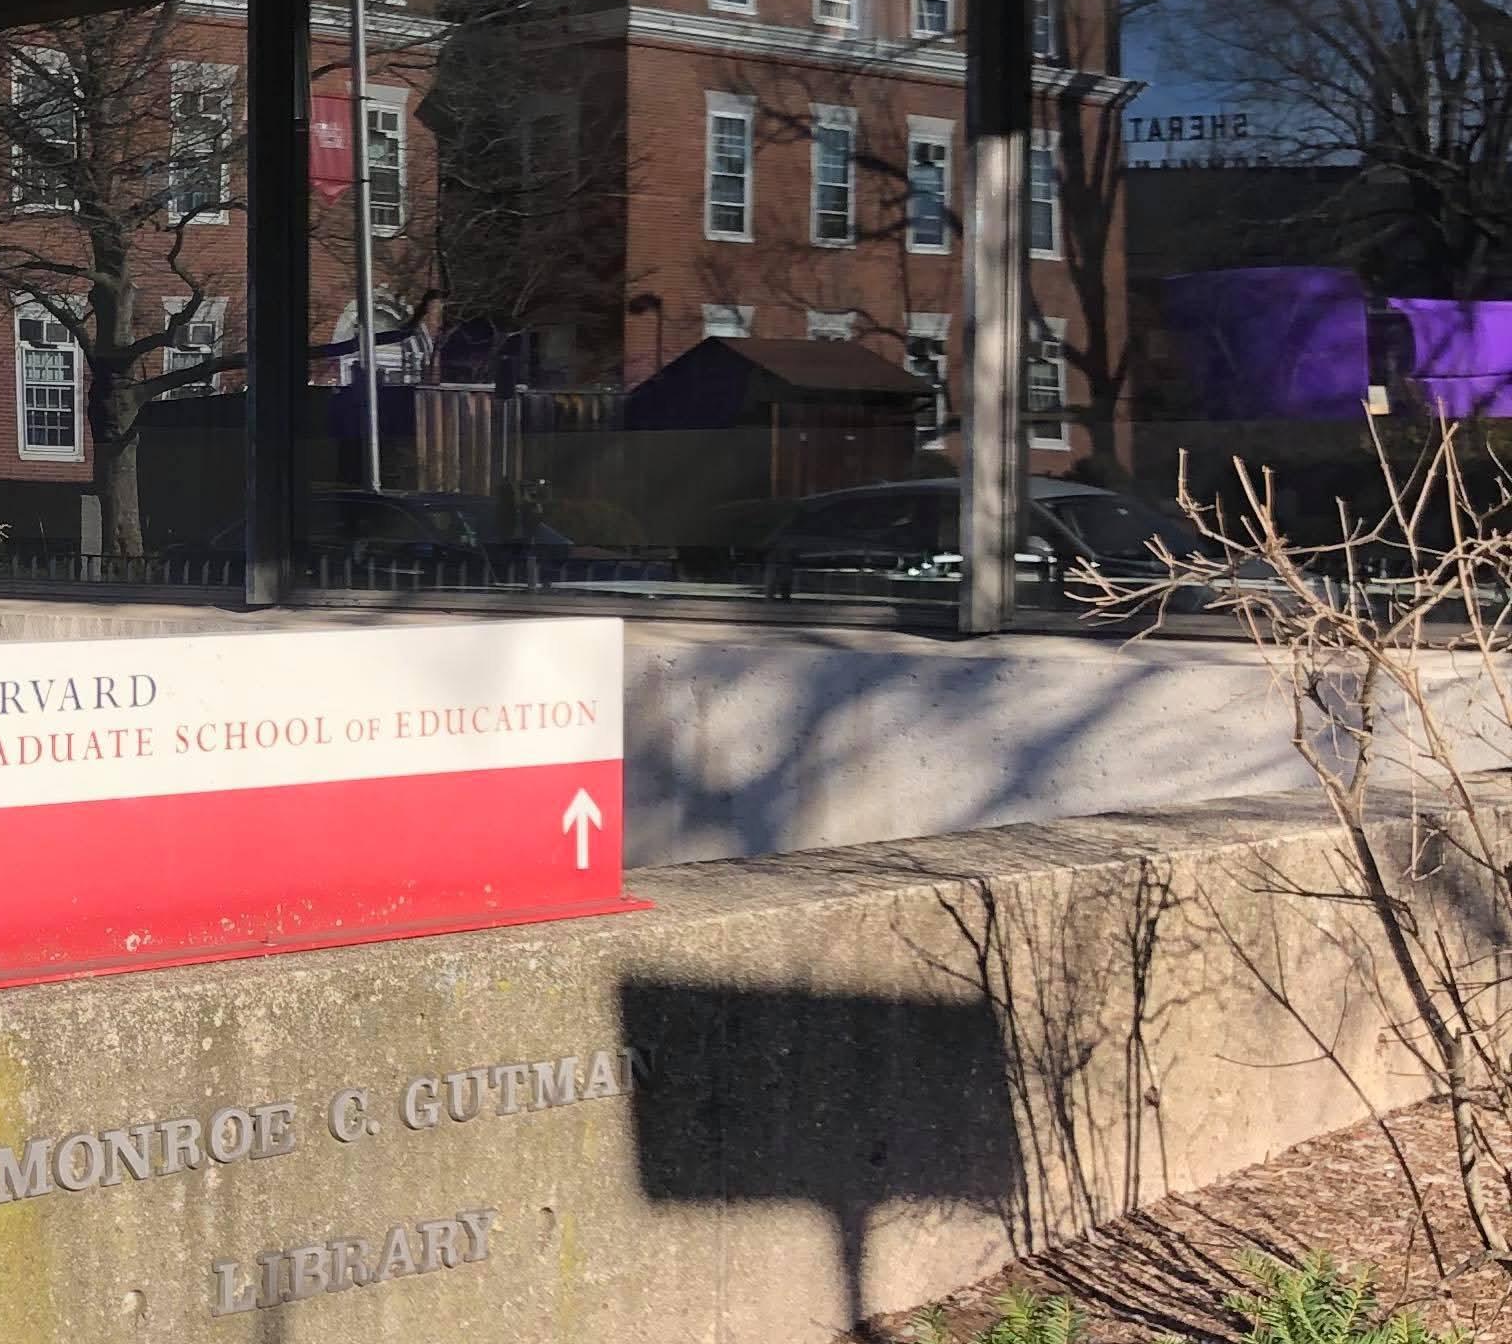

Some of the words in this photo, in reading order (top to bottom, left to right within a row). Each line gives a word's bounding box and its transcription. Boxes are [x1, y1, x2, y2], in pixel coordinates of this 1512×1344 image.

[175, 716, 333, 754] SCHOOL
[345, 717, 381, 744] OF
[395, 698, 599, 739] EDUCATION
[327, 1088, 381, 1143] C.
[211, 1208, 496, 1318] LIBRARY
